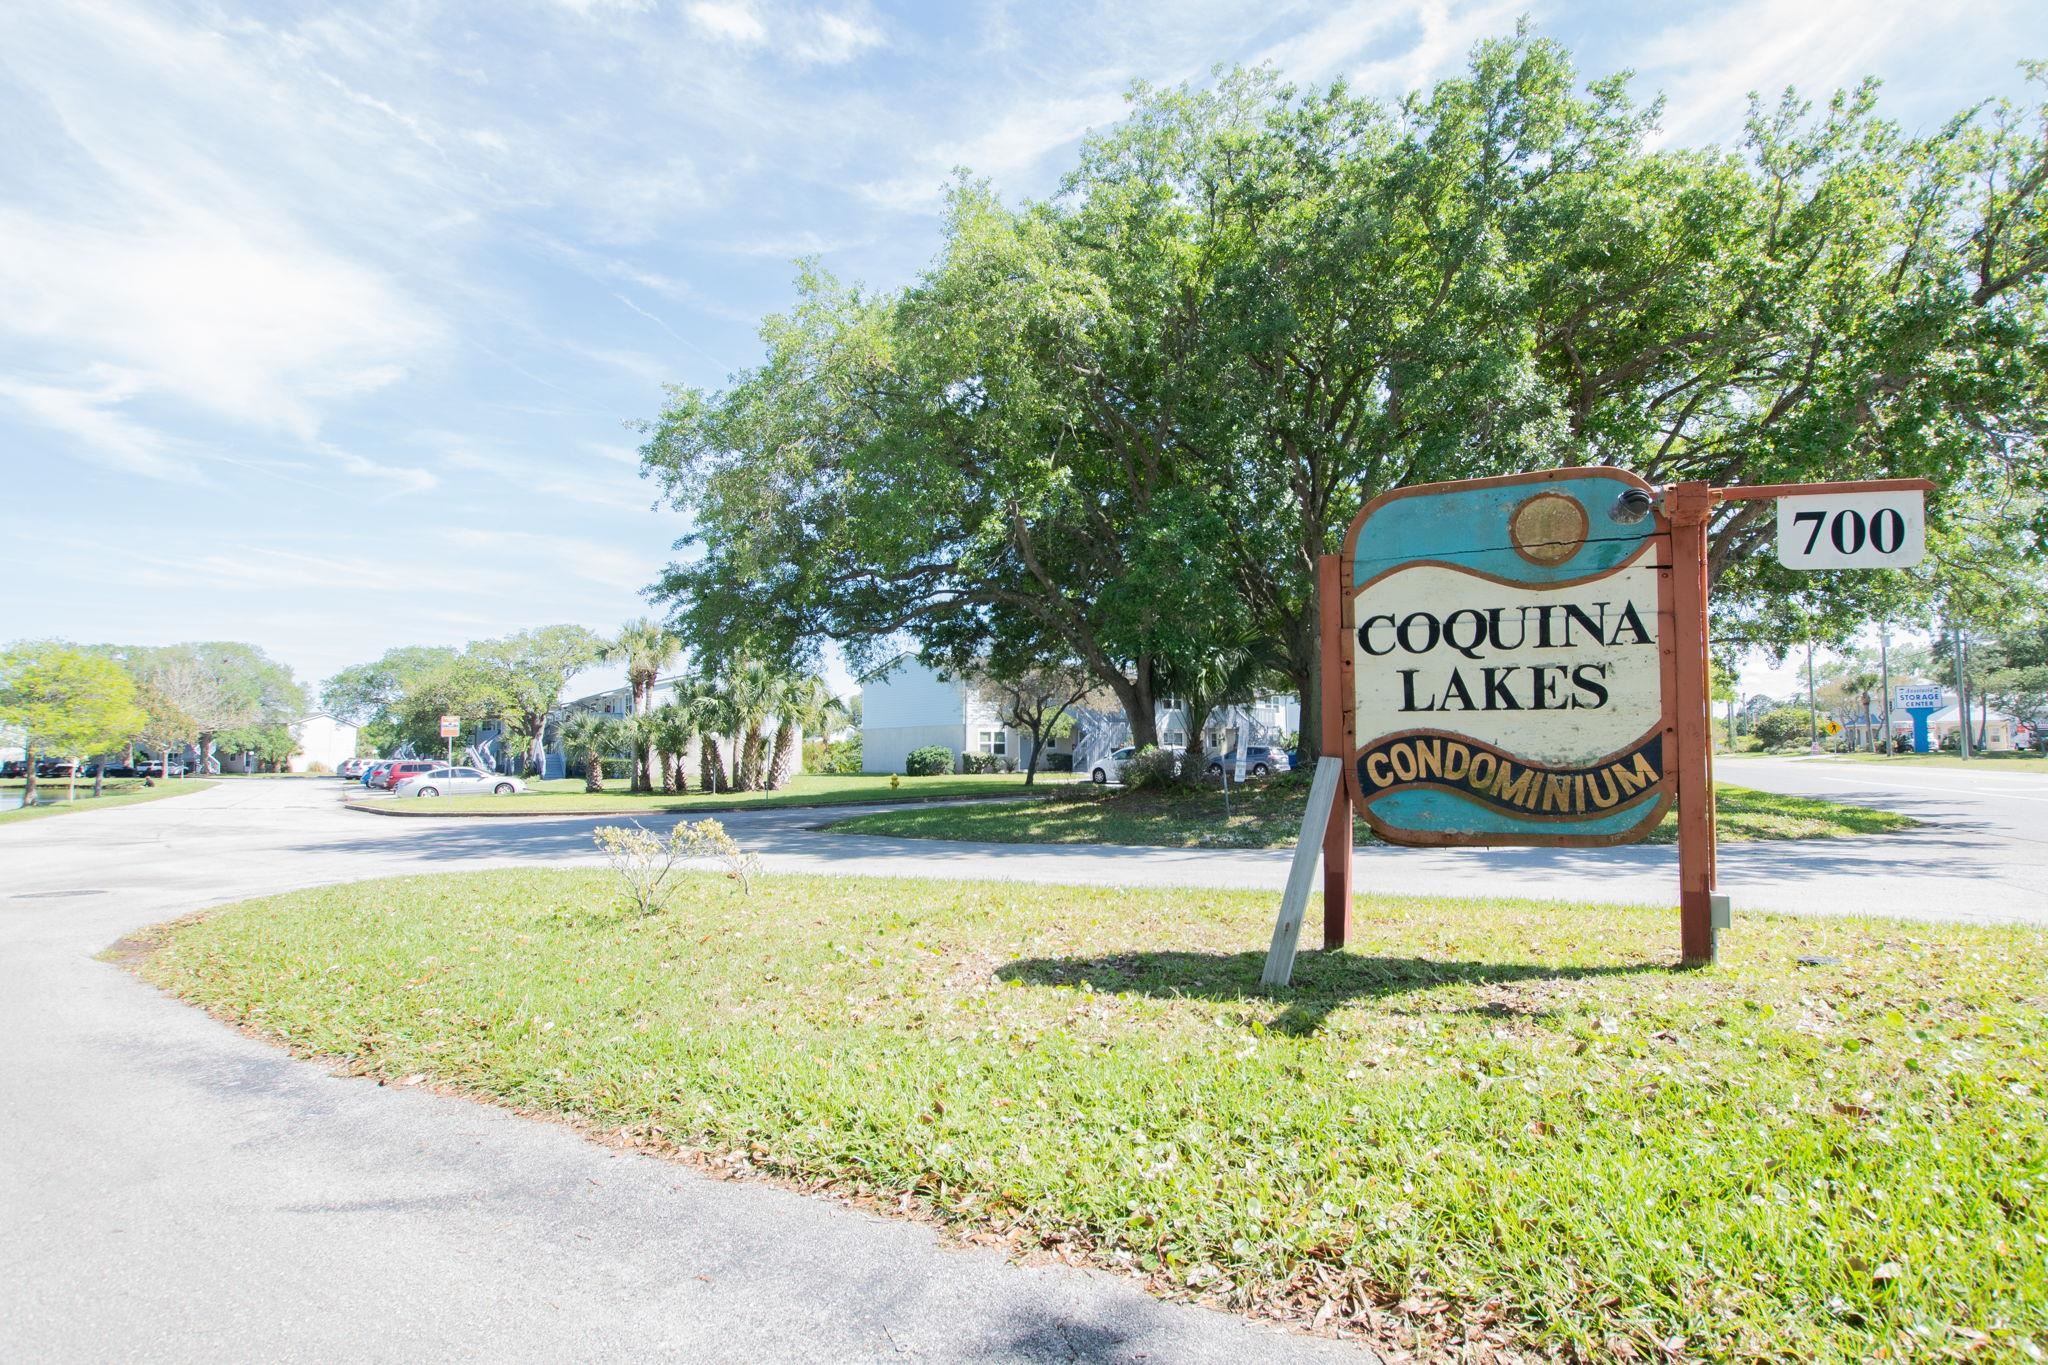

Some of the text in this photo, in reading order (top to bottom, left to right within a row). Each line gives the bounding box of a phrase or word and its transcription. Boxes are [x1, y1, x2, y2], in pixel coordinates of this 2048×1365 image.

[1792, 508, 1905, 555] 700
[1357, 599, 1656, 660] COQUINA
[1396, 664, 1609, 712] LAKES
[1366, 738, 1660, 812] CONDOMINIUM
